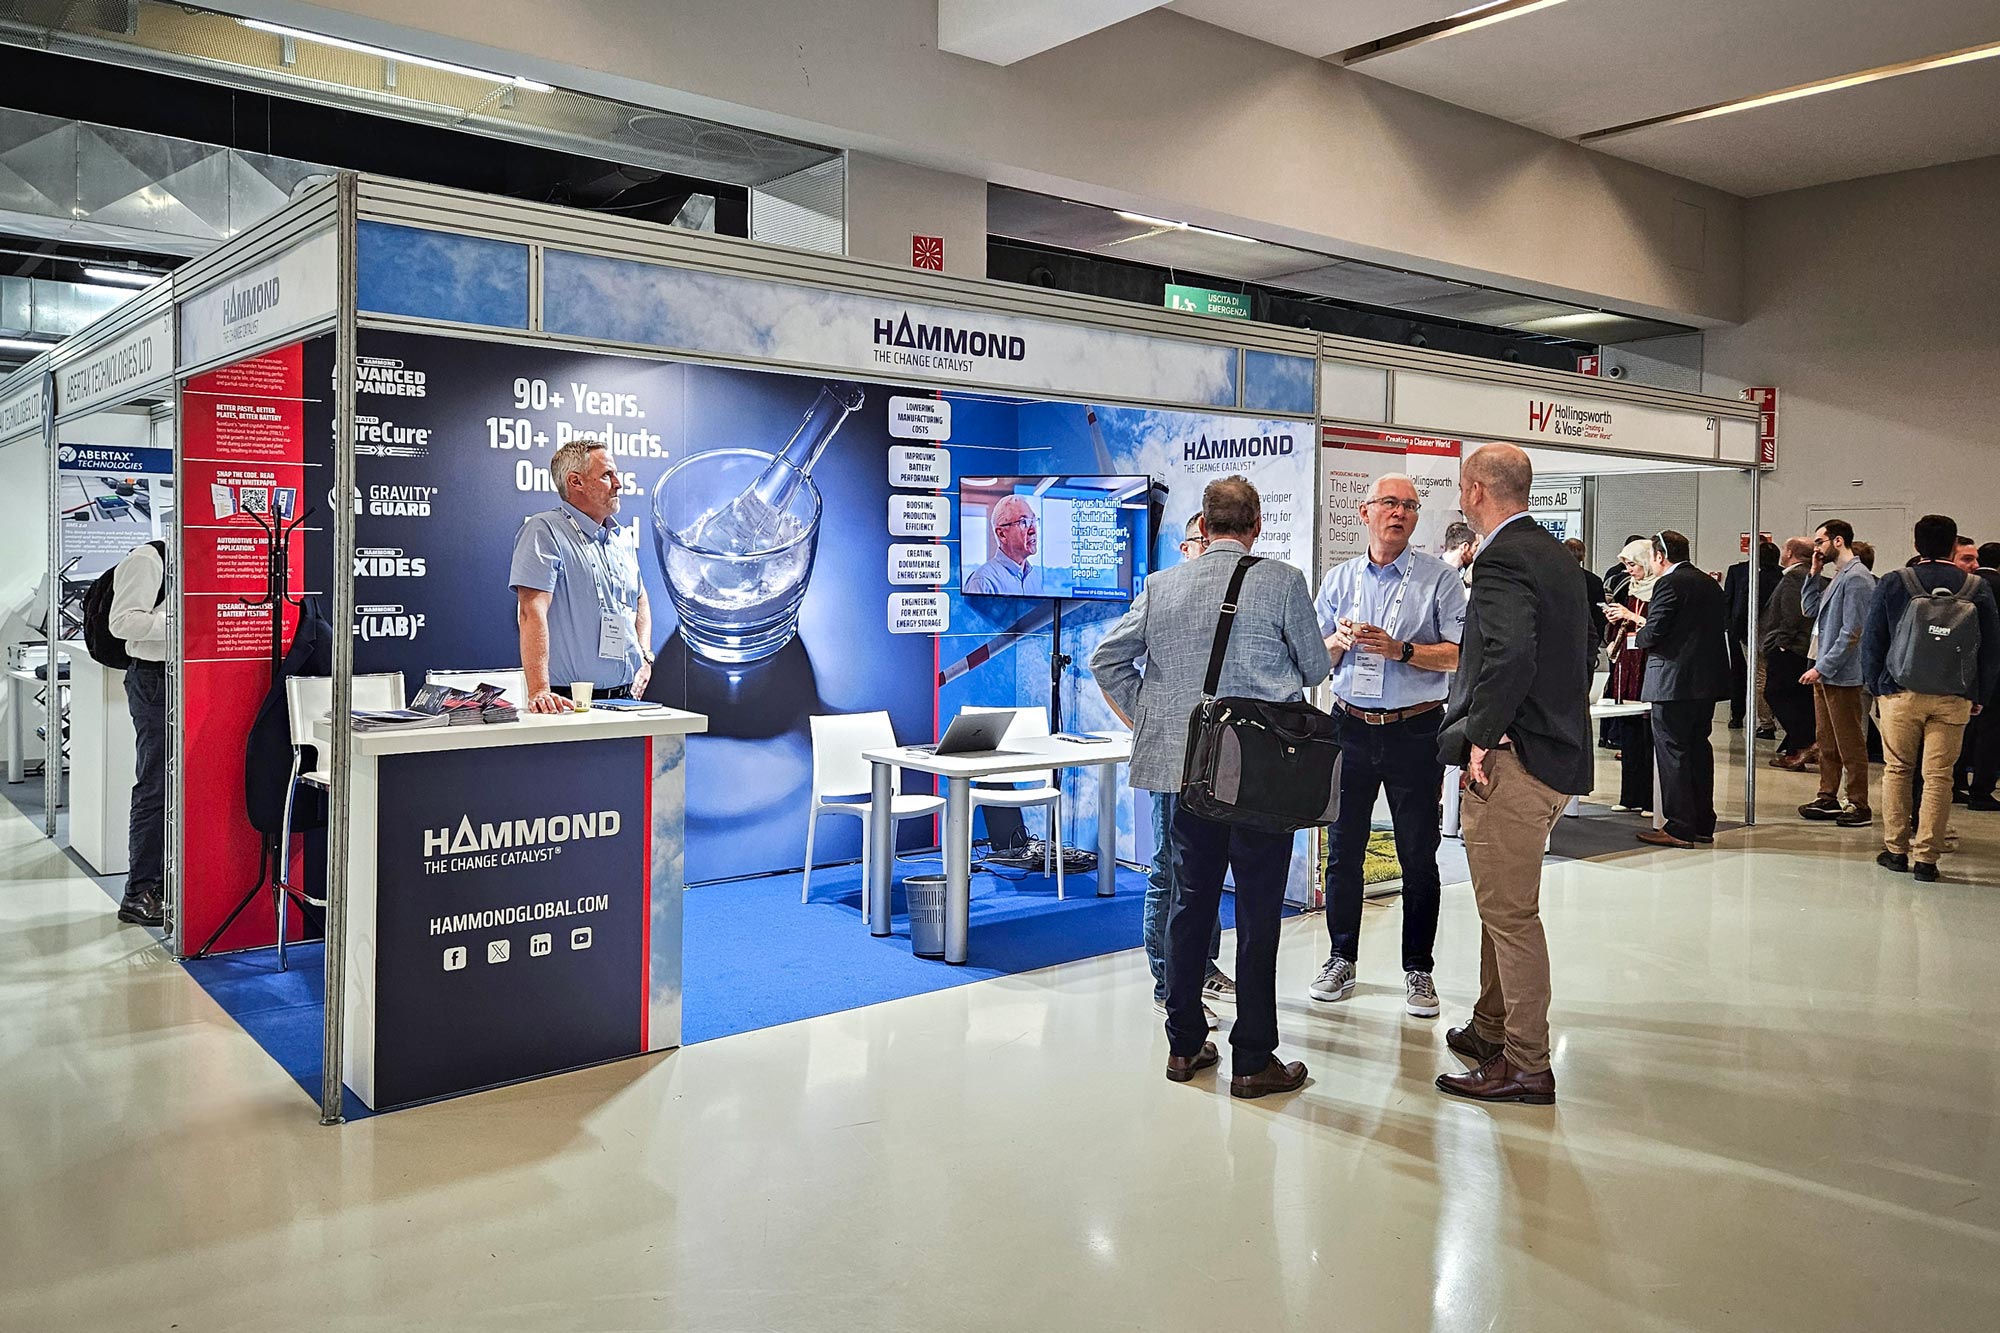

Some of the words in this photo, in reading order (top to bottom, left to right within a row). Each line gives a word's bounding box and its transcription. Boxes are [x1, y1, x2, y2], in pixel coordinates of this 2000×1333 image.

[224, 277, 280, 326] HAMMOND
[1208, 294, 1231, 304] USCITA
[1208, 304, 1247, 316] EMERGENZA
[874, 310, 1025, 361] HAMMOND
[92, 343, 137, 394] TECHNOLOGIES
[139, 337, 152, 374] LTD
[873, 350, 891, 363] THE
[894, 352, 930, 367] CHANGE
[933, 357, 973, 372] CATALYST
[332, 364, 426, 384] VANCED
[332, 379, 426, 397] PANDERS
[513, 378, 564, 410] 90+
[571, 383, 645, 417] Years.
[237, 405, 255, 413] PASTE,
[256, 406, 276, 414] BETTER
[906, 403, 934, 413] LOWERING
[216, 412, 238, 420] PLATES,
[898, 413, 943, 424] MANUFACTURING
[1555, 404, 1611, 424] Hollingsworth
[1555, 420, 1561, 434] &
[1585, 424, 1600, 432] Creating
[1707, 417, 1715, 430] 27
[486, 417, 549, 450] 150+
[912, 425, 928, 434] COSTS
[1184, 433, 1293, 460] HAMMOND
[1414, 438, 1434, 446] Cleaner
[905, 452, 935, 461] IMPROVING
[78, 460, 143, 470] TECHNOLOGIES
[909, 463, 932, 471] BATTERY
[1184, 464, 1194, 473] THE
[1197, 462, 1220, 472] CHANGE
[901, 474, 939, 483] PERFORMANCE
[1407, 474, 1452, 488] ollingsworth
[1330, 479, 1347, 492] The
[1350, 481, 1369, 493] Next
[907, 501, 933, 509] BOOSTING
[1072, 499, 1084, 508] For
[1096, 500, 1103, 508] to
[1105, 499, 1121, 508] kind
[1528, 494, 1553, 506] stems
[1555, 493, 1567, 505] AB
[370, 502, 430, 516] GUARD
[903, 512, 936, 520] PRODUCTION
[1072, 513, 1080, 521] of
[1082, 513, 1100, 522] build
[1102, 513, 1117, 522] that
[1280, 510, 1291, 521] for
[1330, 512, 1366, 528] Negativ
[1072, 527, 1090, 535] trust
[1092, 527, 1097, 536] &
[1099, 527, 1129, 538] rapport,
[1261, 531, 1291, 543] storage
[1330, 528, 1359, 544] Design
[1072, 542, 1083, 550] we
[1084, 540, 1103, 550] have
[1104, 541, 1112, 550] to
[1114, 542, 1126, 551] get
[1072, 555, 1079, 563] to
[1081, 556, 1100, 564] meet
[1102, 555, 1123, 564] those
[354, 558, 426, 576] XIDES
[920, 571, 941, 579] SAVINGS
[1072, 568, 1100, 578] people.
[902, 598, 936, 606] ENGINEERING
[918, 619, 941, 627] STORAGE
[424, 810, 620, 857] HAMMOND
[424, 860, 447, 874] THE
[451, 854, 498, 872] CHANGE
[430, 894, 609, 935] HAMMONDGLOBAL.COM
